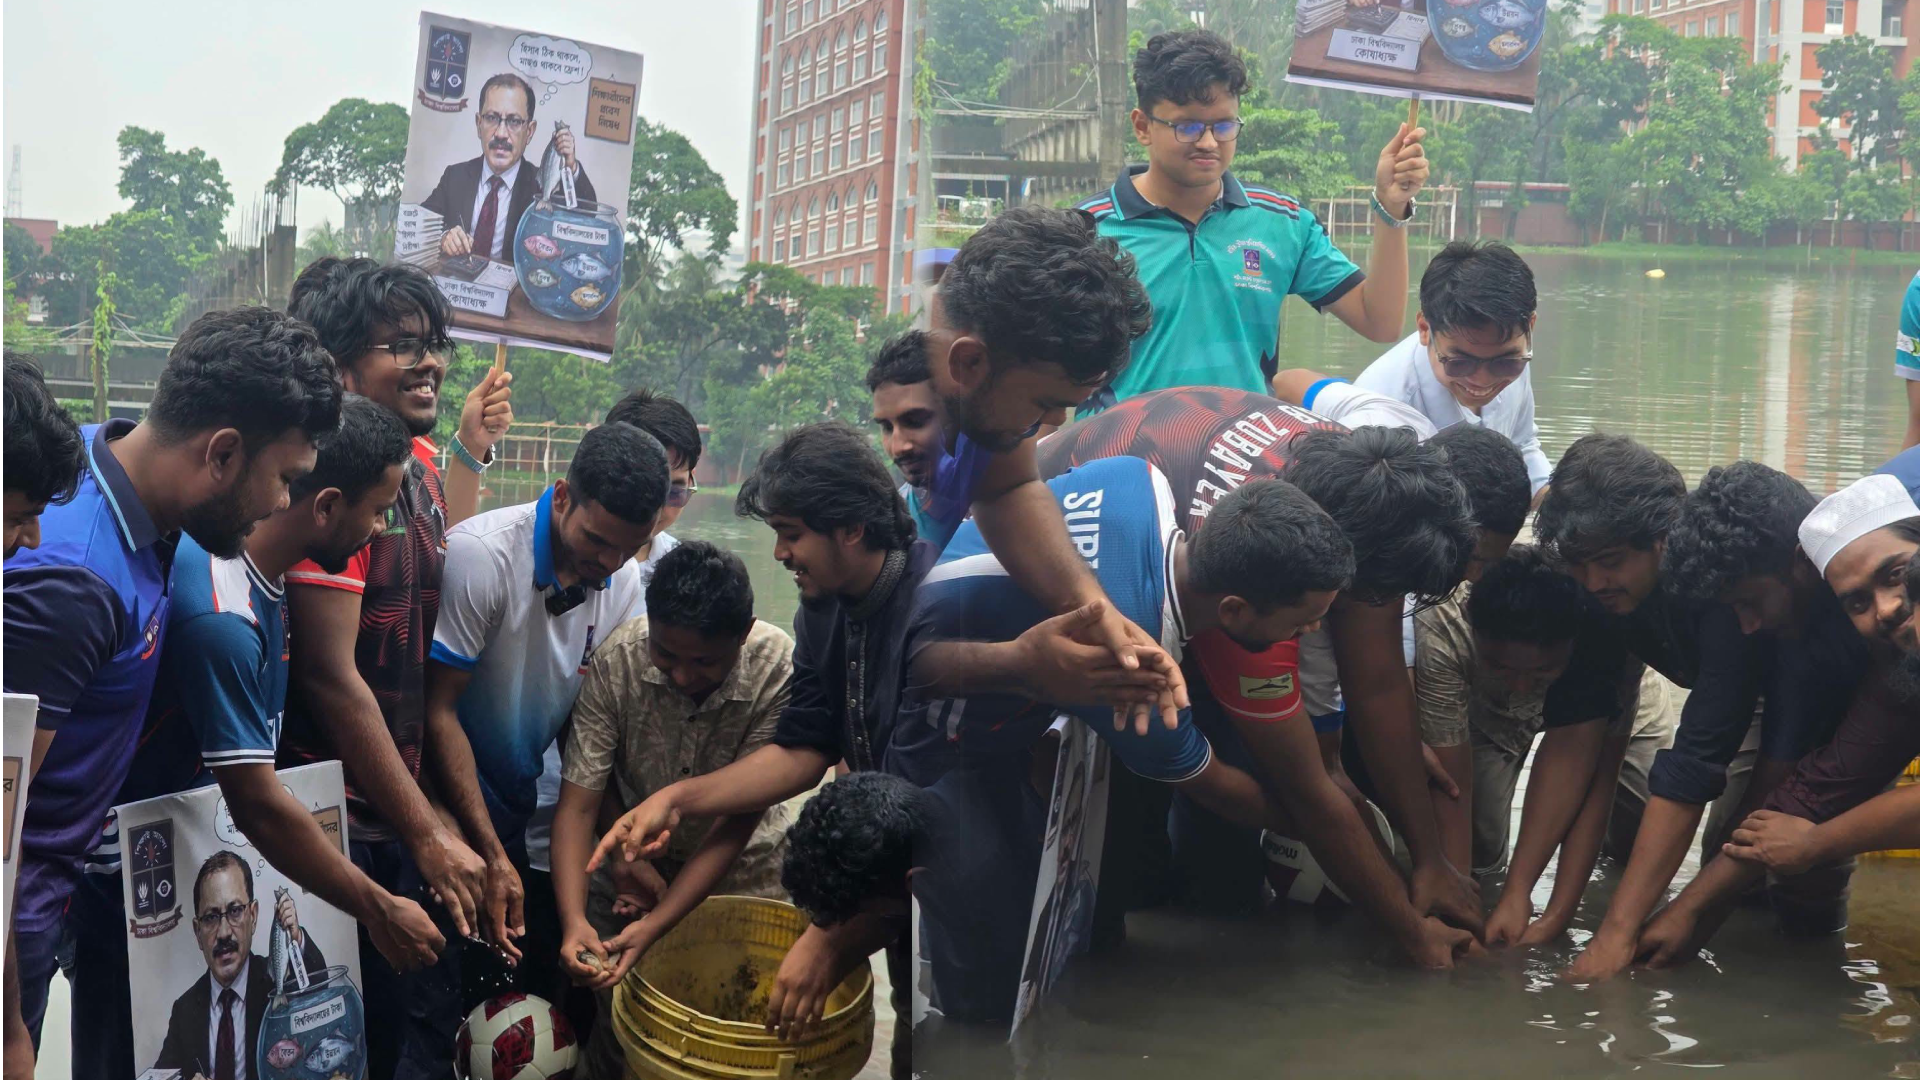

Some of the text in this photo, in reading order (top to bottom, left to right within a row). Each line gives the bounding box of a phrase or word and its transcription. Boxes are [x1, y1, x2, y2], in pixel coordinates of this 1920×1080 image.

[1351, 35, 1405, 52] ঢাকা বিশ্ববিদ্যালয়
[520, 42, 581, 64] হিসাব ঠিক থাকলে,
[1355, 48, 1398, 63] কোষাধ্যক্ষ
[520, 57, 538, 68] মাছও
[540, 61, 562, 72] থাকবে
[591, 86, 631, 105] শিক্ষার্থীদের
[600, 104, 620, 117] প্রবেশ
[598, 115, 620, 130] নিষেধ
[556, 224, 607, 241] বিশ্ববিদ্যালয়ের টাকা
[444, 282, 494, 299] ঢাকা বিশ্ববিদ্যালয়
[449, 293, 488, 309] কোষাধ্যক্ষ
[1189, 411, 1291, 519] ZUBAYER
[1063, 488, 1104, 569] SUP
[294, 1002, 343, 1029] বিশ্ববিদ্যালয়ের টাকা
[281, 1048, 295, 1058] বেতন
